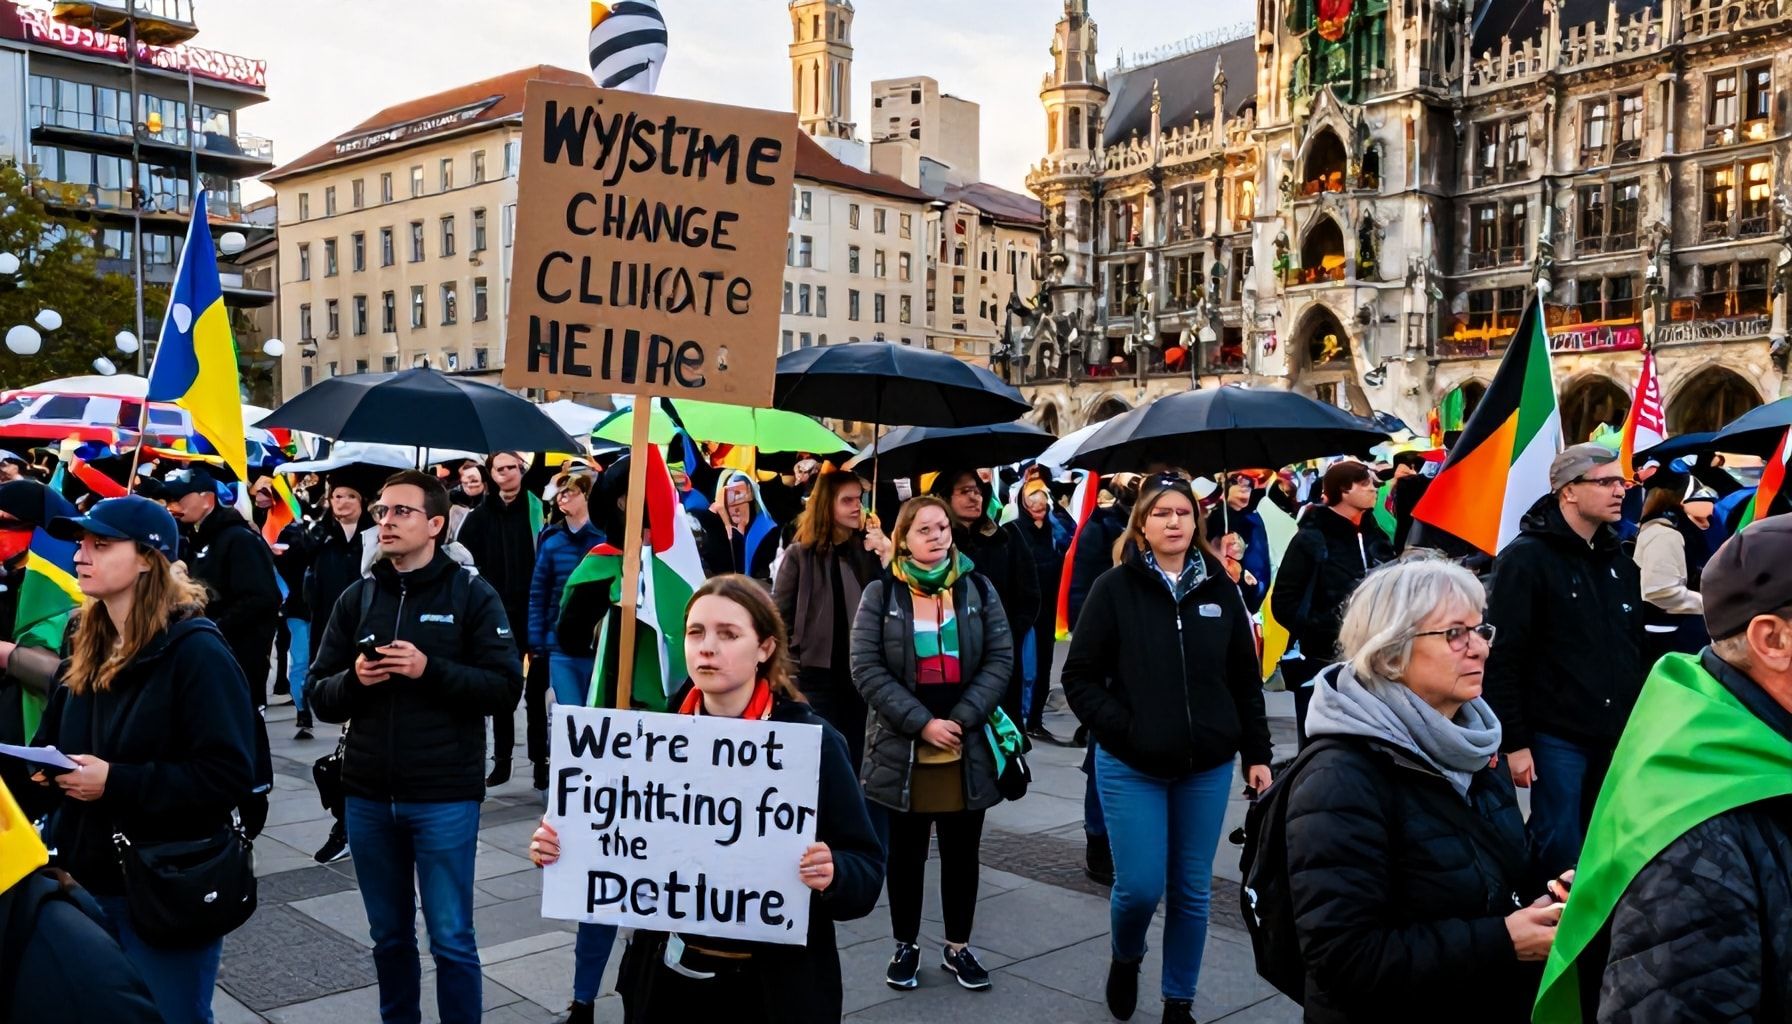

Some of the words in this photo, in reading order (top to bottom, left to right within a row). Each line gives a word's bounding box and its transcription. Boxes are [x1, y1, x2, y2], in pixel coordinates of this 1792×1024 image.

[566, 192, 739, 251] CHANGE
[567, 715, 689, 762] We're
[712, 730, 784, 770] not
[756, 787, 815, 837] for
[598, 826, 648, 859] the
